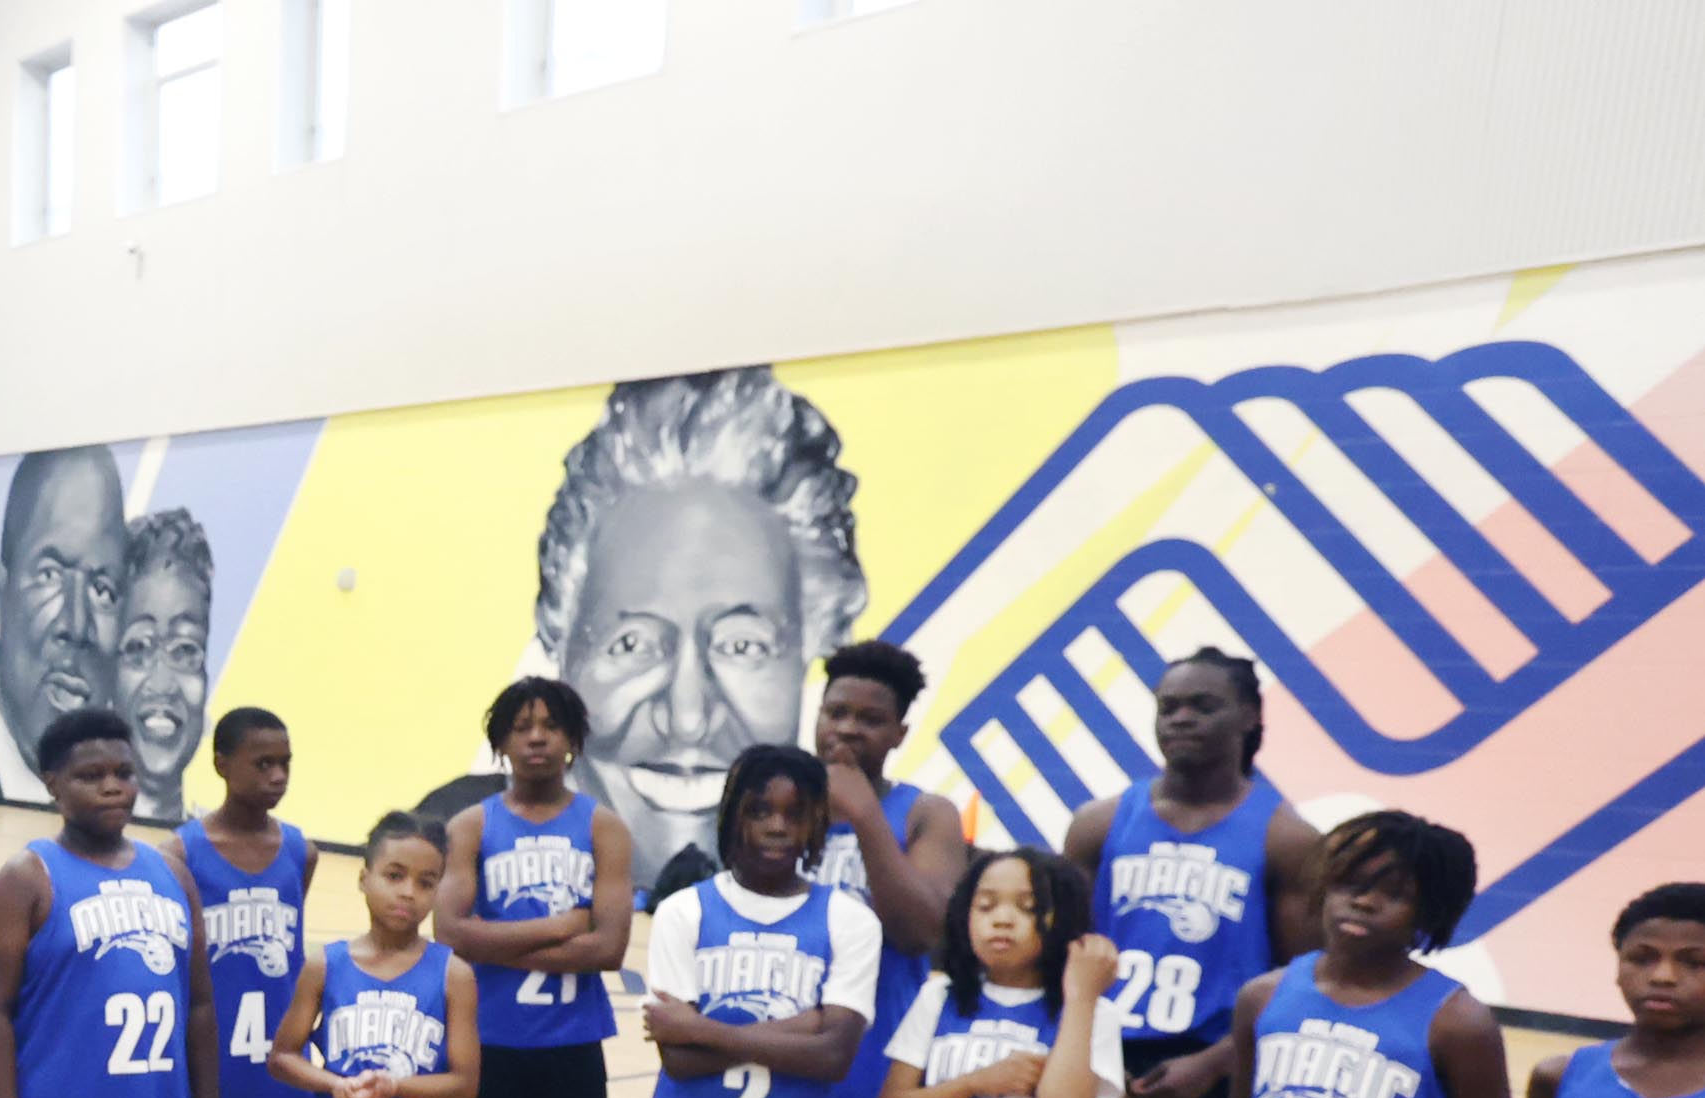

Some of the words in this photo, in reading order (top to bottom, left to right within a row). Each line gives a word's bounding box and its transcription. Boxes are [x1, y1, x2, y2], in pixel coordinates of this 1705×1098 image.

[484, 851, 595, 902] MAGIC
[1112, 855, 1252, 923] MAGIC
[70, 896, 189, 953] MAGIC
[202, 903, 298, 951] MAGIC
[696, 947, 826, 1011] MAGIC
[1117, 949, 1202, 1033] 28
[105, 991, 175, 1075] 22
[230, 991, 273, 1064] 4
[328, 1005, 445, 1072] MAGIC
